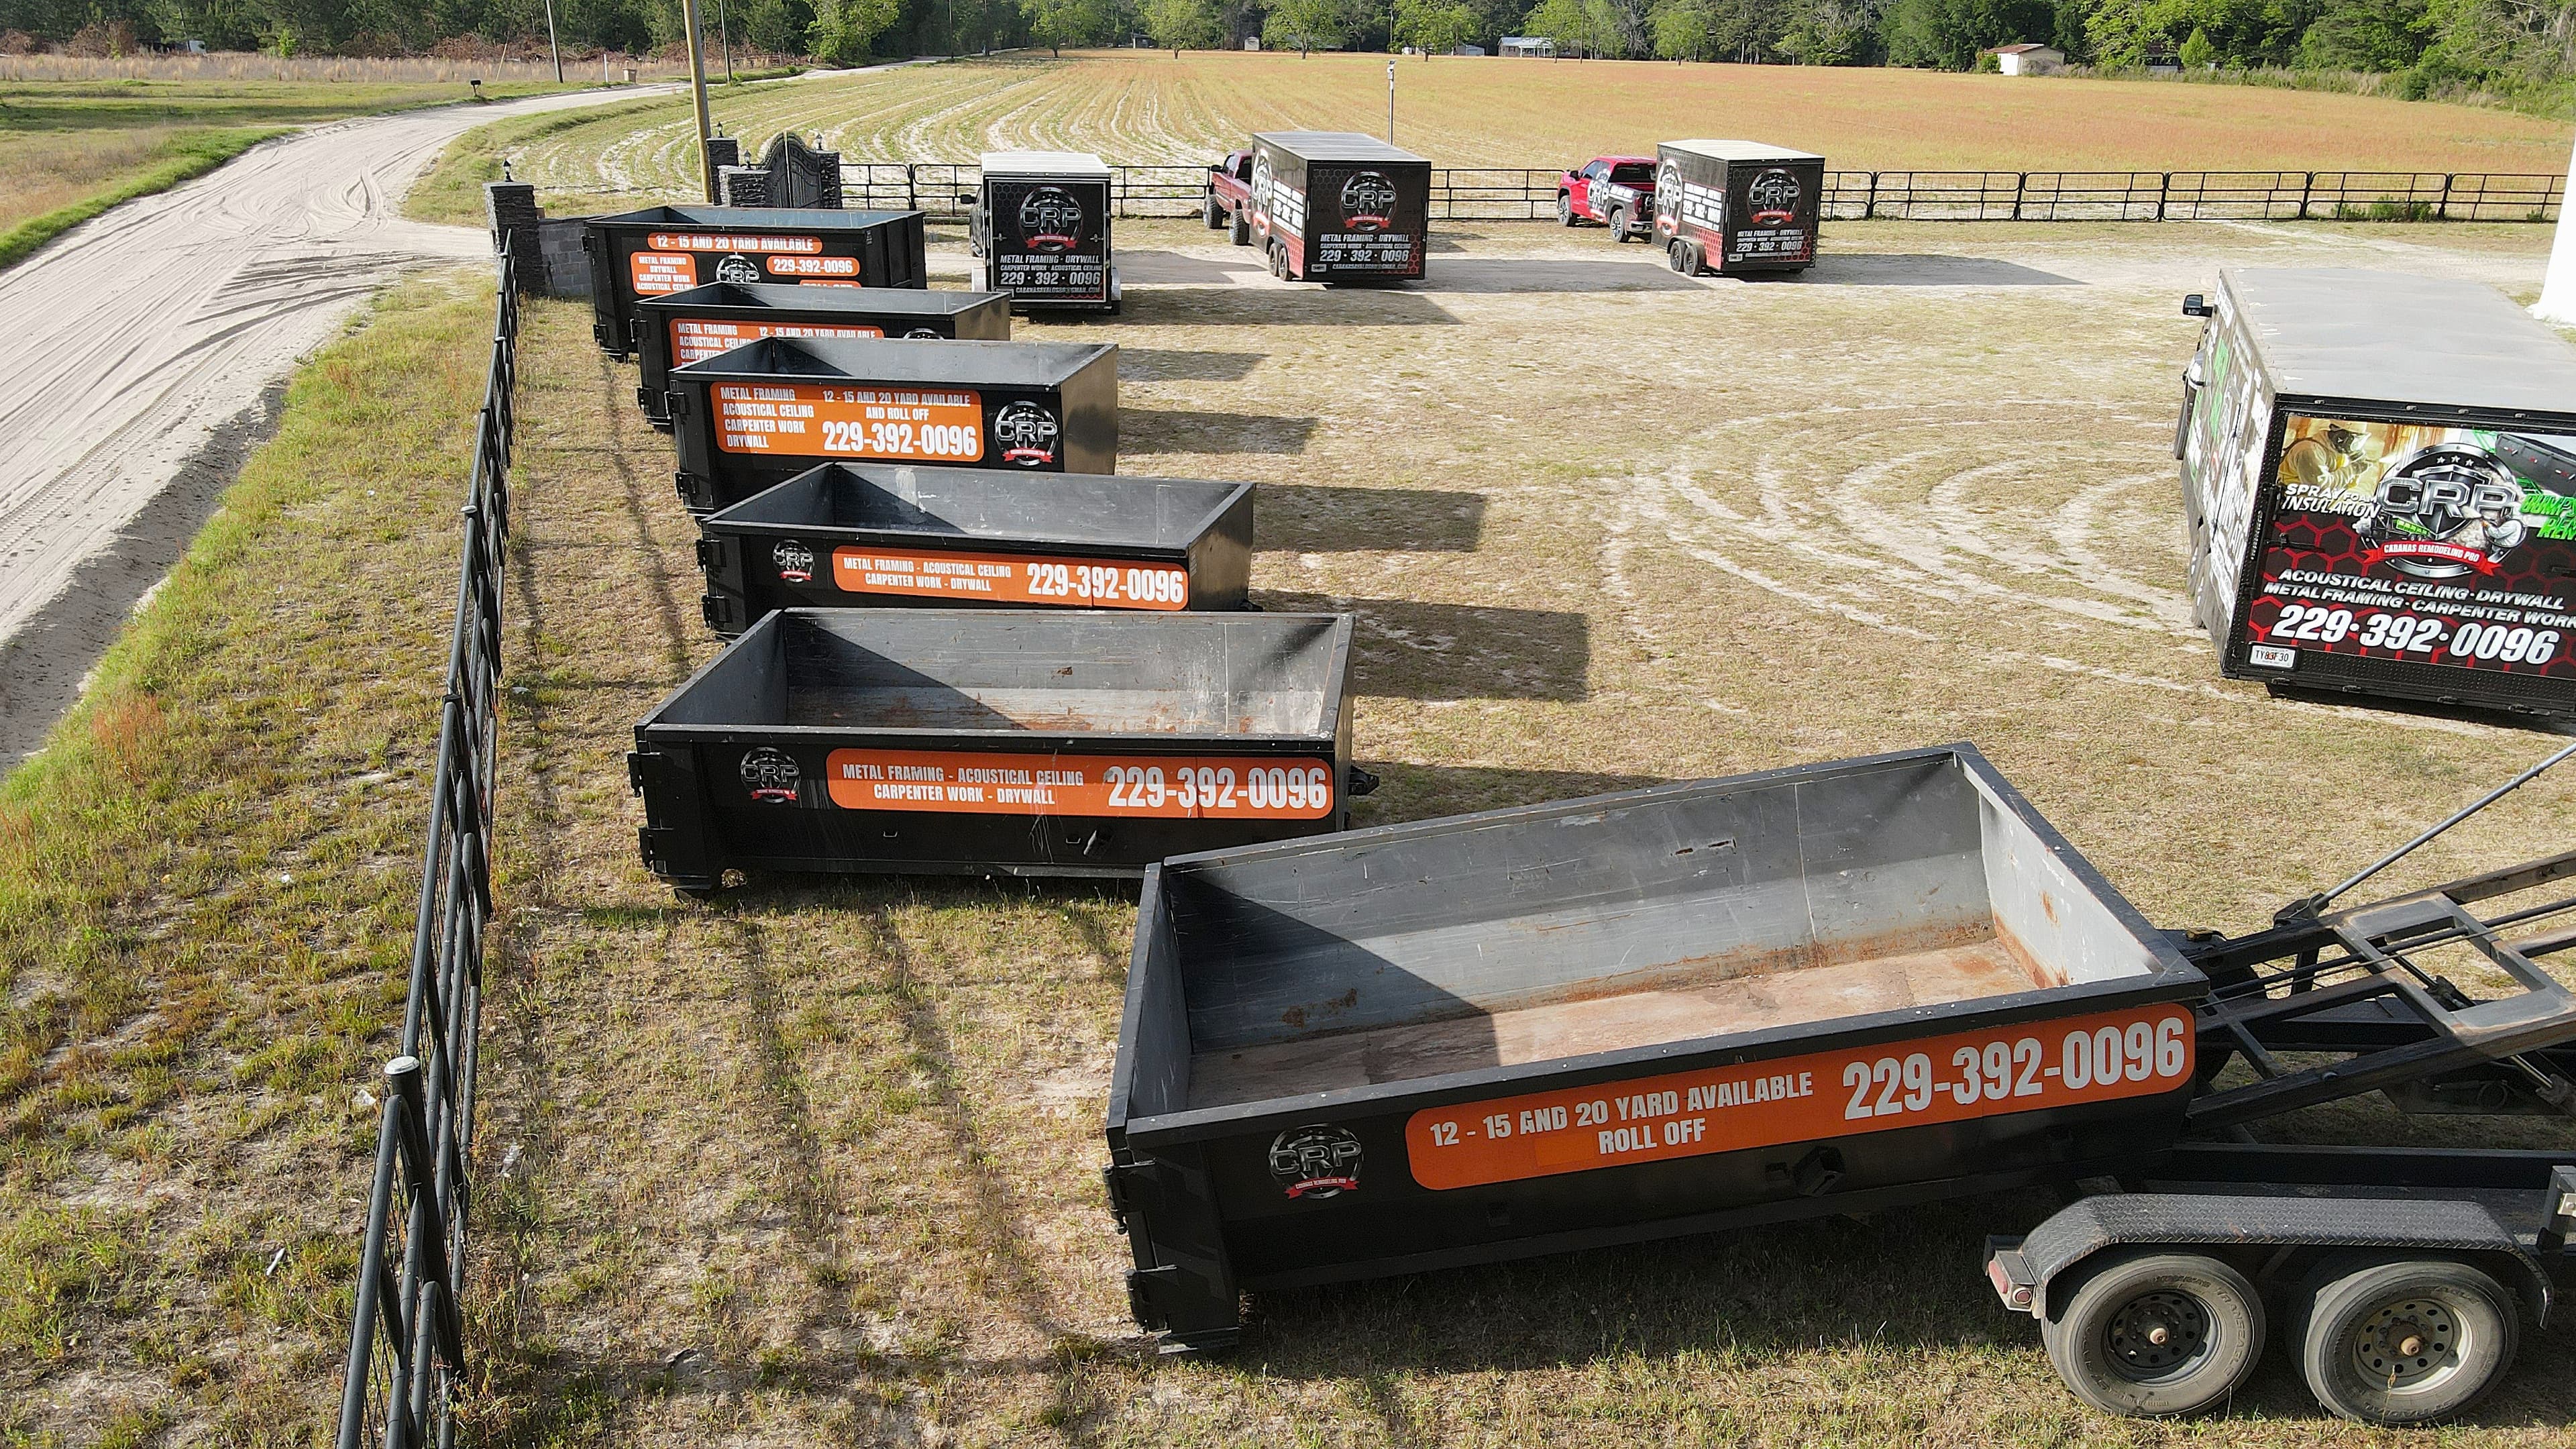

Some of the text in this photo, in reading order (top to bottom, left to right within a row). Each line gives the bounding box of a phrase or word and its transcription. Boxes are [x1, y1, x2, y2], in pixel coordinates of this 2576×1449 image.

[1342, 190, 1396, 209] CRP
[1749, 186, 1801, 204] CRP
[1020, 207, 1082, 227] CRP
[655, 235, 668, 248] 12
[678, 236, 690, 248] 15
[692, 237, 712, 249] AND
[714, 237, 729, 249] 20
[731, 237, 758, 250] YARD
[761, 237, 814, 251] AVAILABLE
[1758, 241, 1775, 251] 392
[638, 256, 659, 264] METAL
[1000, 255, 1024, 264] METAL
[1026, 255, 1059, 264] FRAMING
[1065, 255, 1099, 264] DRYWALL
[1320, 250, 1342, 262] 229
[1350, 250, 1373, 262] 392
[773, 258, 853, 274] 229-392-0096
[1000, 272, 1025, 285] 229
[1034, 272, 1059, 285] 392
[1069, 272, 1101, 285] 0096
[678, 323, 738, 335] METAL FRAMING
[759, 327, 767, 336] 12
[775, 327, 784, 337] 15
[679, 336, 723, 347] ACOUSTICAL
[720, 387, 796, 401] METAL FRAMING
[822, 390, 835, 402] 12
[843, 391, 854, 402] 15
[857, 392, 876, 403] AND
[878, 392, 892, 404] 20
[894, 392, 918, 405] YARD
[921, 394, 971, 407] AVAILABLE
[723, 403, 814, 418] ACOUSTICAL CEILING
[866, 407, 929, 421] AND ROLL OFF
[724, 419, 806, 433] CARPENTER WORK
[995, 421, 1058, 442] CRP
[727, 435, 769, 448] DRYWALL
[822, 421, 977, 456] 229-392-0096
[2285, 483, 2377, 503] SPRAY FOAM
[2377, 478, 2517, 519] CRP
[2281, 496, 2381, 518] INSULATION
[773, 549, 814, 567] CRP
[2383, 543, 2480, 562] CABANAS REMODELING PRO
[843, 557, 873, 570] METAL
[874, 559, 914, 572] FRAMING
[923, 561, 976, 576] ACOUSTICAL
[977, 565, 1012, 578] CEILING
[865, 573, 914, 587] CARPENTER
[916, 576, 942, 588] WORK
[951, 578, 991, 591] DRYWALL
[1027, 563, 1184, 603] 229-392-0096
[2278, 568, 2392, 592] ACOUSTICAL
[2394, 581, 2470, 600] CEILING
[2475, 589, 2565, 610] DRYWALL
[2263, 582, 2320, 599] METAL
[2321, 588, 2404, 608] FRAMING
[2412, 600, 2522, 623] CARPENTER
[741, 764, 799, 783] CRP
[843, 763, 884, 780] METAL
[888, 765, 944, 782] FRAMING
[957, 767, 1033, 784] ACOUSTICAL
[1036, 771, 1083, 786] CEILING
[874, 784, 943, 801] CARPENTER
[947, 786, 984, 802] WORK
[997, 788, 1055, 805] DRYWALL
[1107, 765, 1327, 809] 229-392-0096
[1842, 1016, 2186, 1121] 229-392-0096
[1430, 1121, 1460, 1147] 12
[1483, 1114, 1511, 1139] 15
[1519, 1106, 1568, 1135] AND
[1575, 1100, 1609, 1127] 20
[1615, 1090, 1678, 1121] YARD
[1687, 1071, 1813, 1112] AVAILABLE
[1598, 1118, 1706, 1155] ROLL OFF
[1269, 1140, 1361, 1175] CRP
